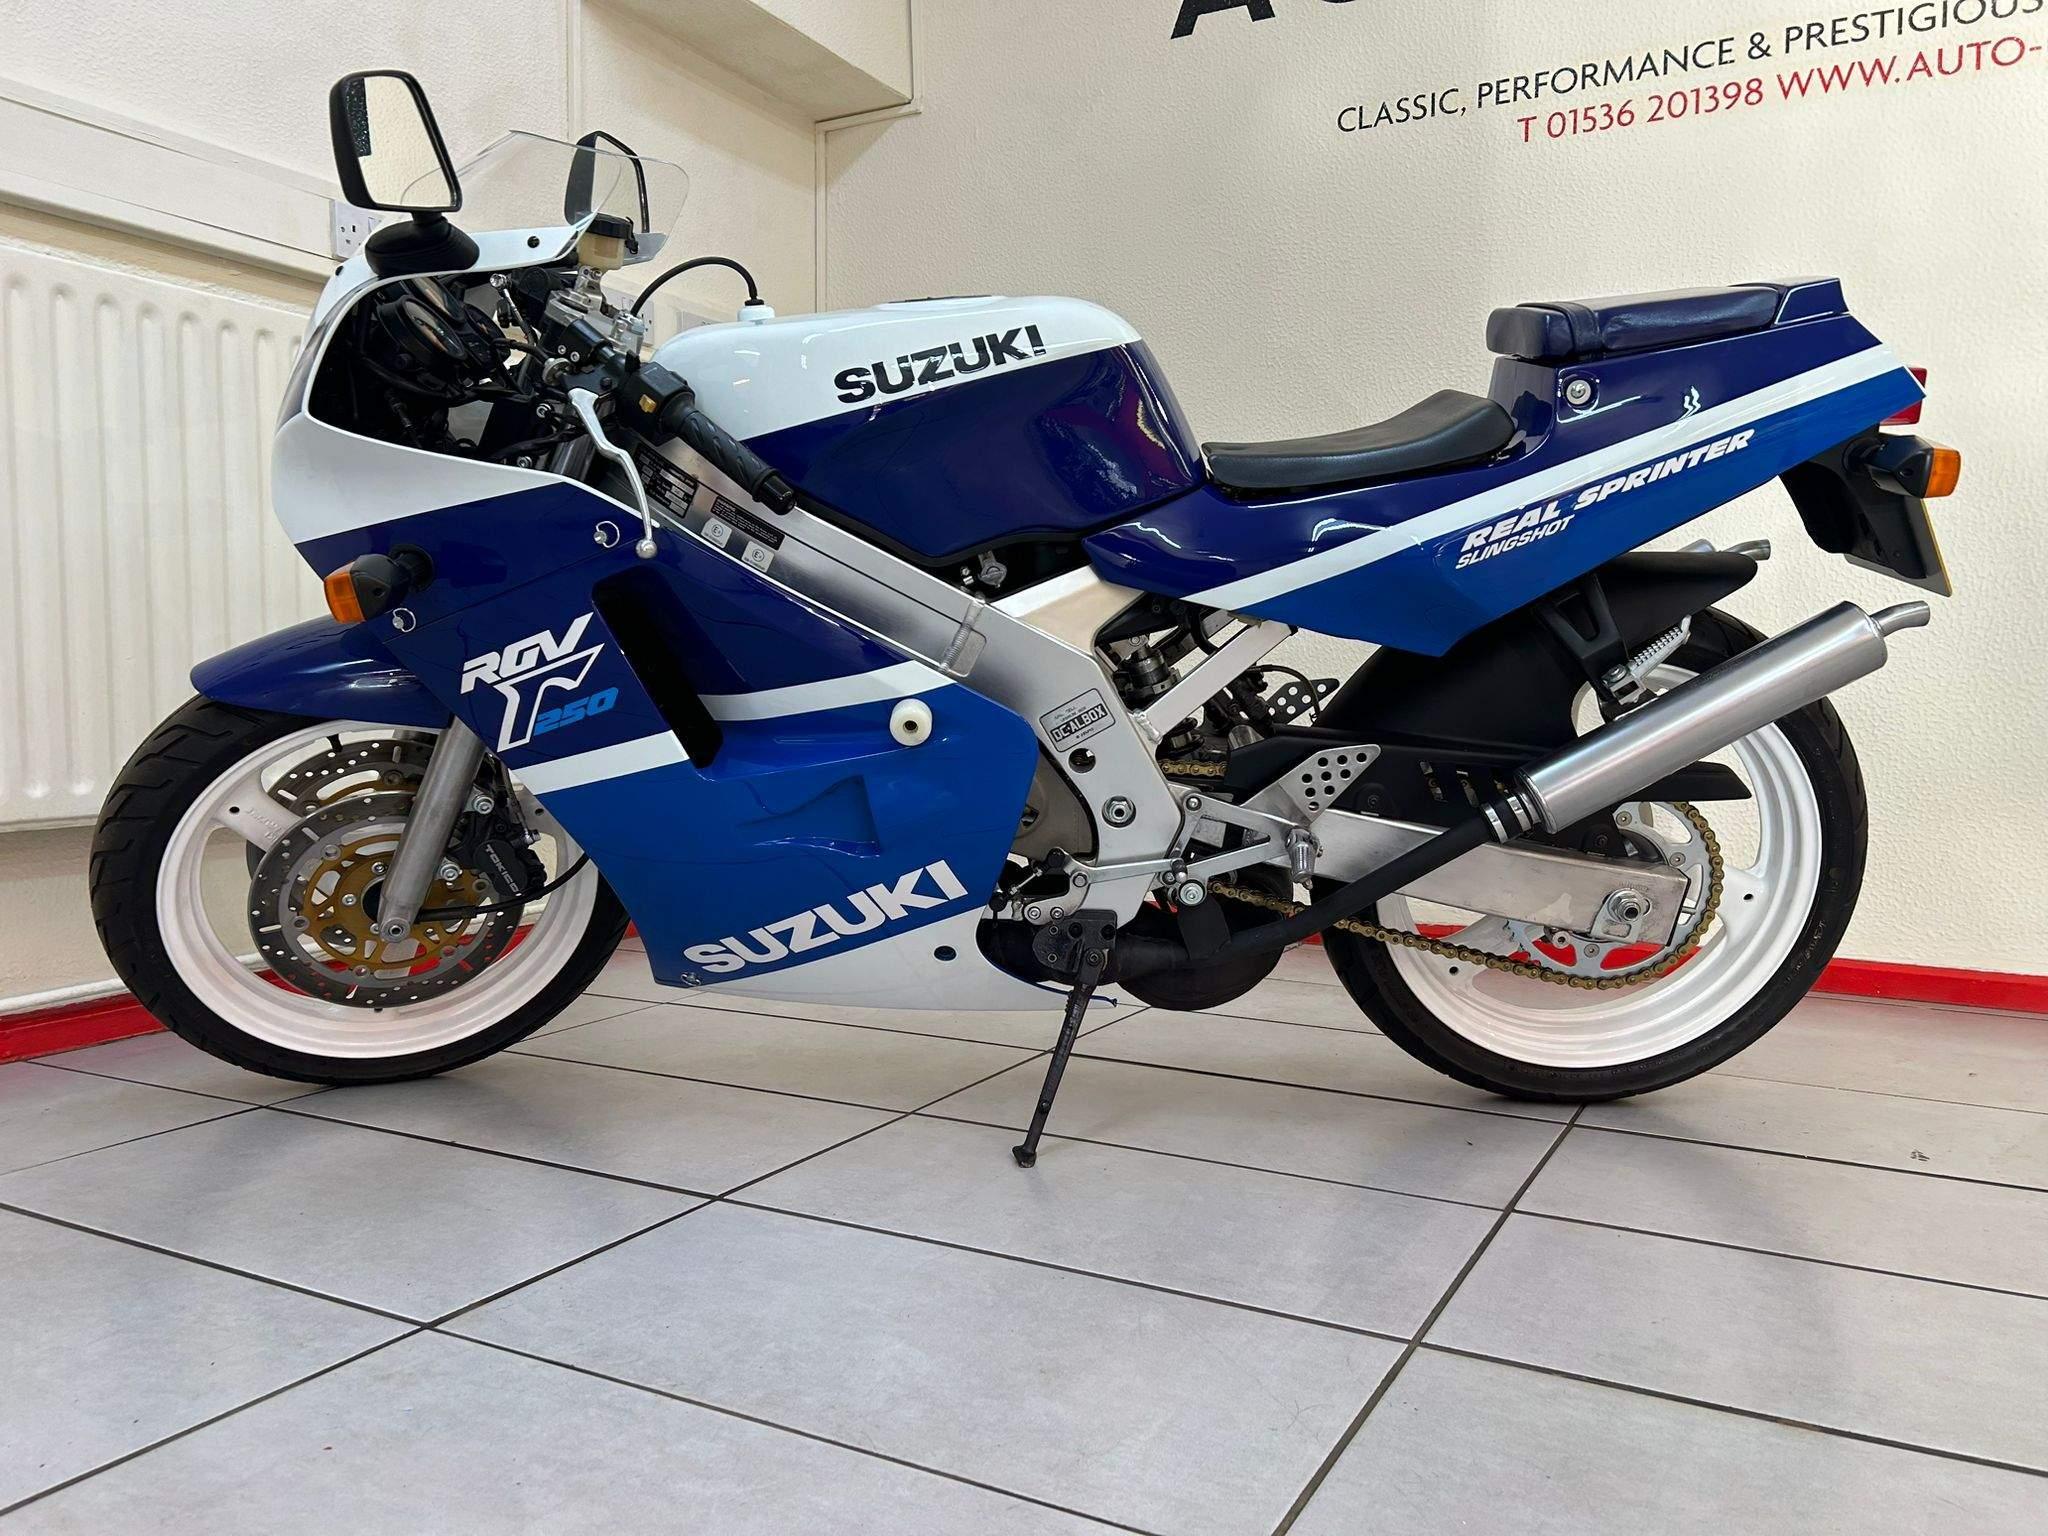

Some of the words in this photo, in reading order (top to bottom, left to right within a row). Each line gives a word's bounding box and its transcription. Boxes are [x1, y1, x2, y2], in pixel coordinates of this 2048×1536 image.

[1337, 88, 1466, 132] CLASSIC,
[1477, 37, 1735, 108] PERFORMANCE
[1747, 32, 1772, 60] &
[1517, 115, 1537, 142] T
[1547, 99, 1635, 138] 01536
[1647, 78, 1763, 123] 201398
[834, 324, 1047, 403] SUZUKI
[1461, 500, 1562, 552] REAL
[1573, 429, 1755, 511] SPRINTER
[1455, 514, 1575, 569] SLINGSHOT
[460, 612, 594, 694] RGV
[533, 687, 619, 736] 250
[486, 843, 520, 893] TOKICO
[684, 859, 968, 972] SUZUKI
